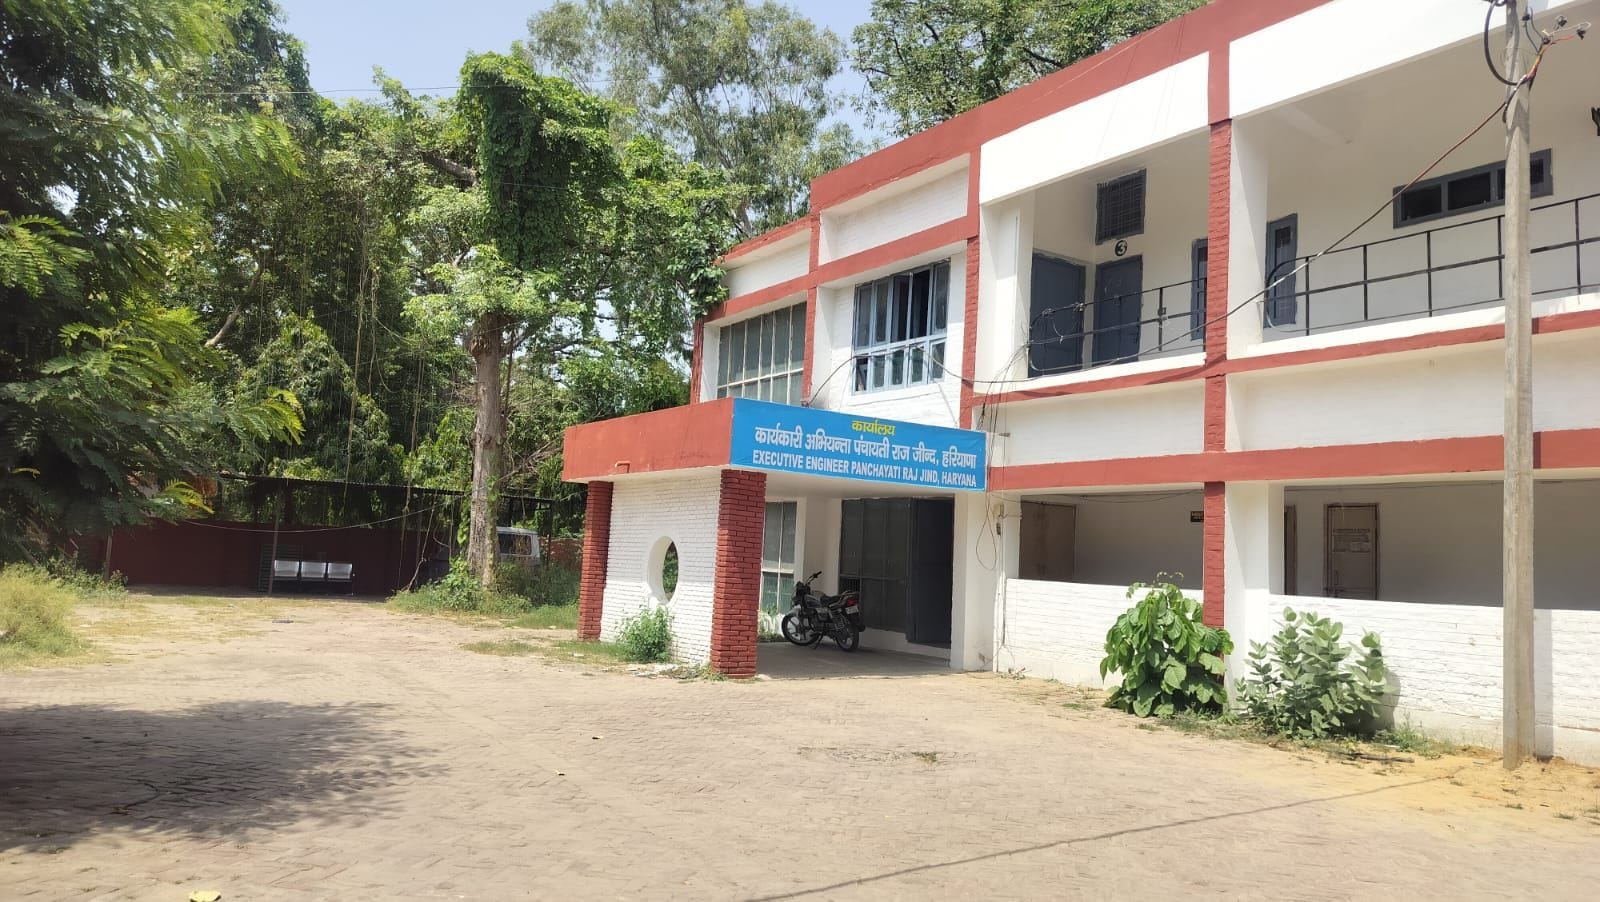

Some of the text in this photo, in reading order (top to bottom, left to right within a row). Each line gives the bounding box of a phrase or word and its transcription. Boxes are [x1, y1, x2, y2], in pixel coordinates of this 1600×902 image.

[1117, 240, 1126, 255] 3
[852, 419, 896, 436] कार्यालय
[755, 422, 803, 449] कार्यकारी
[805, 428, 852, 454] अभियन्ता
[853, 434, 889, 459] पंचायती
[892, 444, 910, 461] राज
[942, 445, 977, 469] हरियाणा
[753, 449, 977, 487] EXECUTIVE ENGINEER PANCHAYATI RAJ JIND, HARYANA
